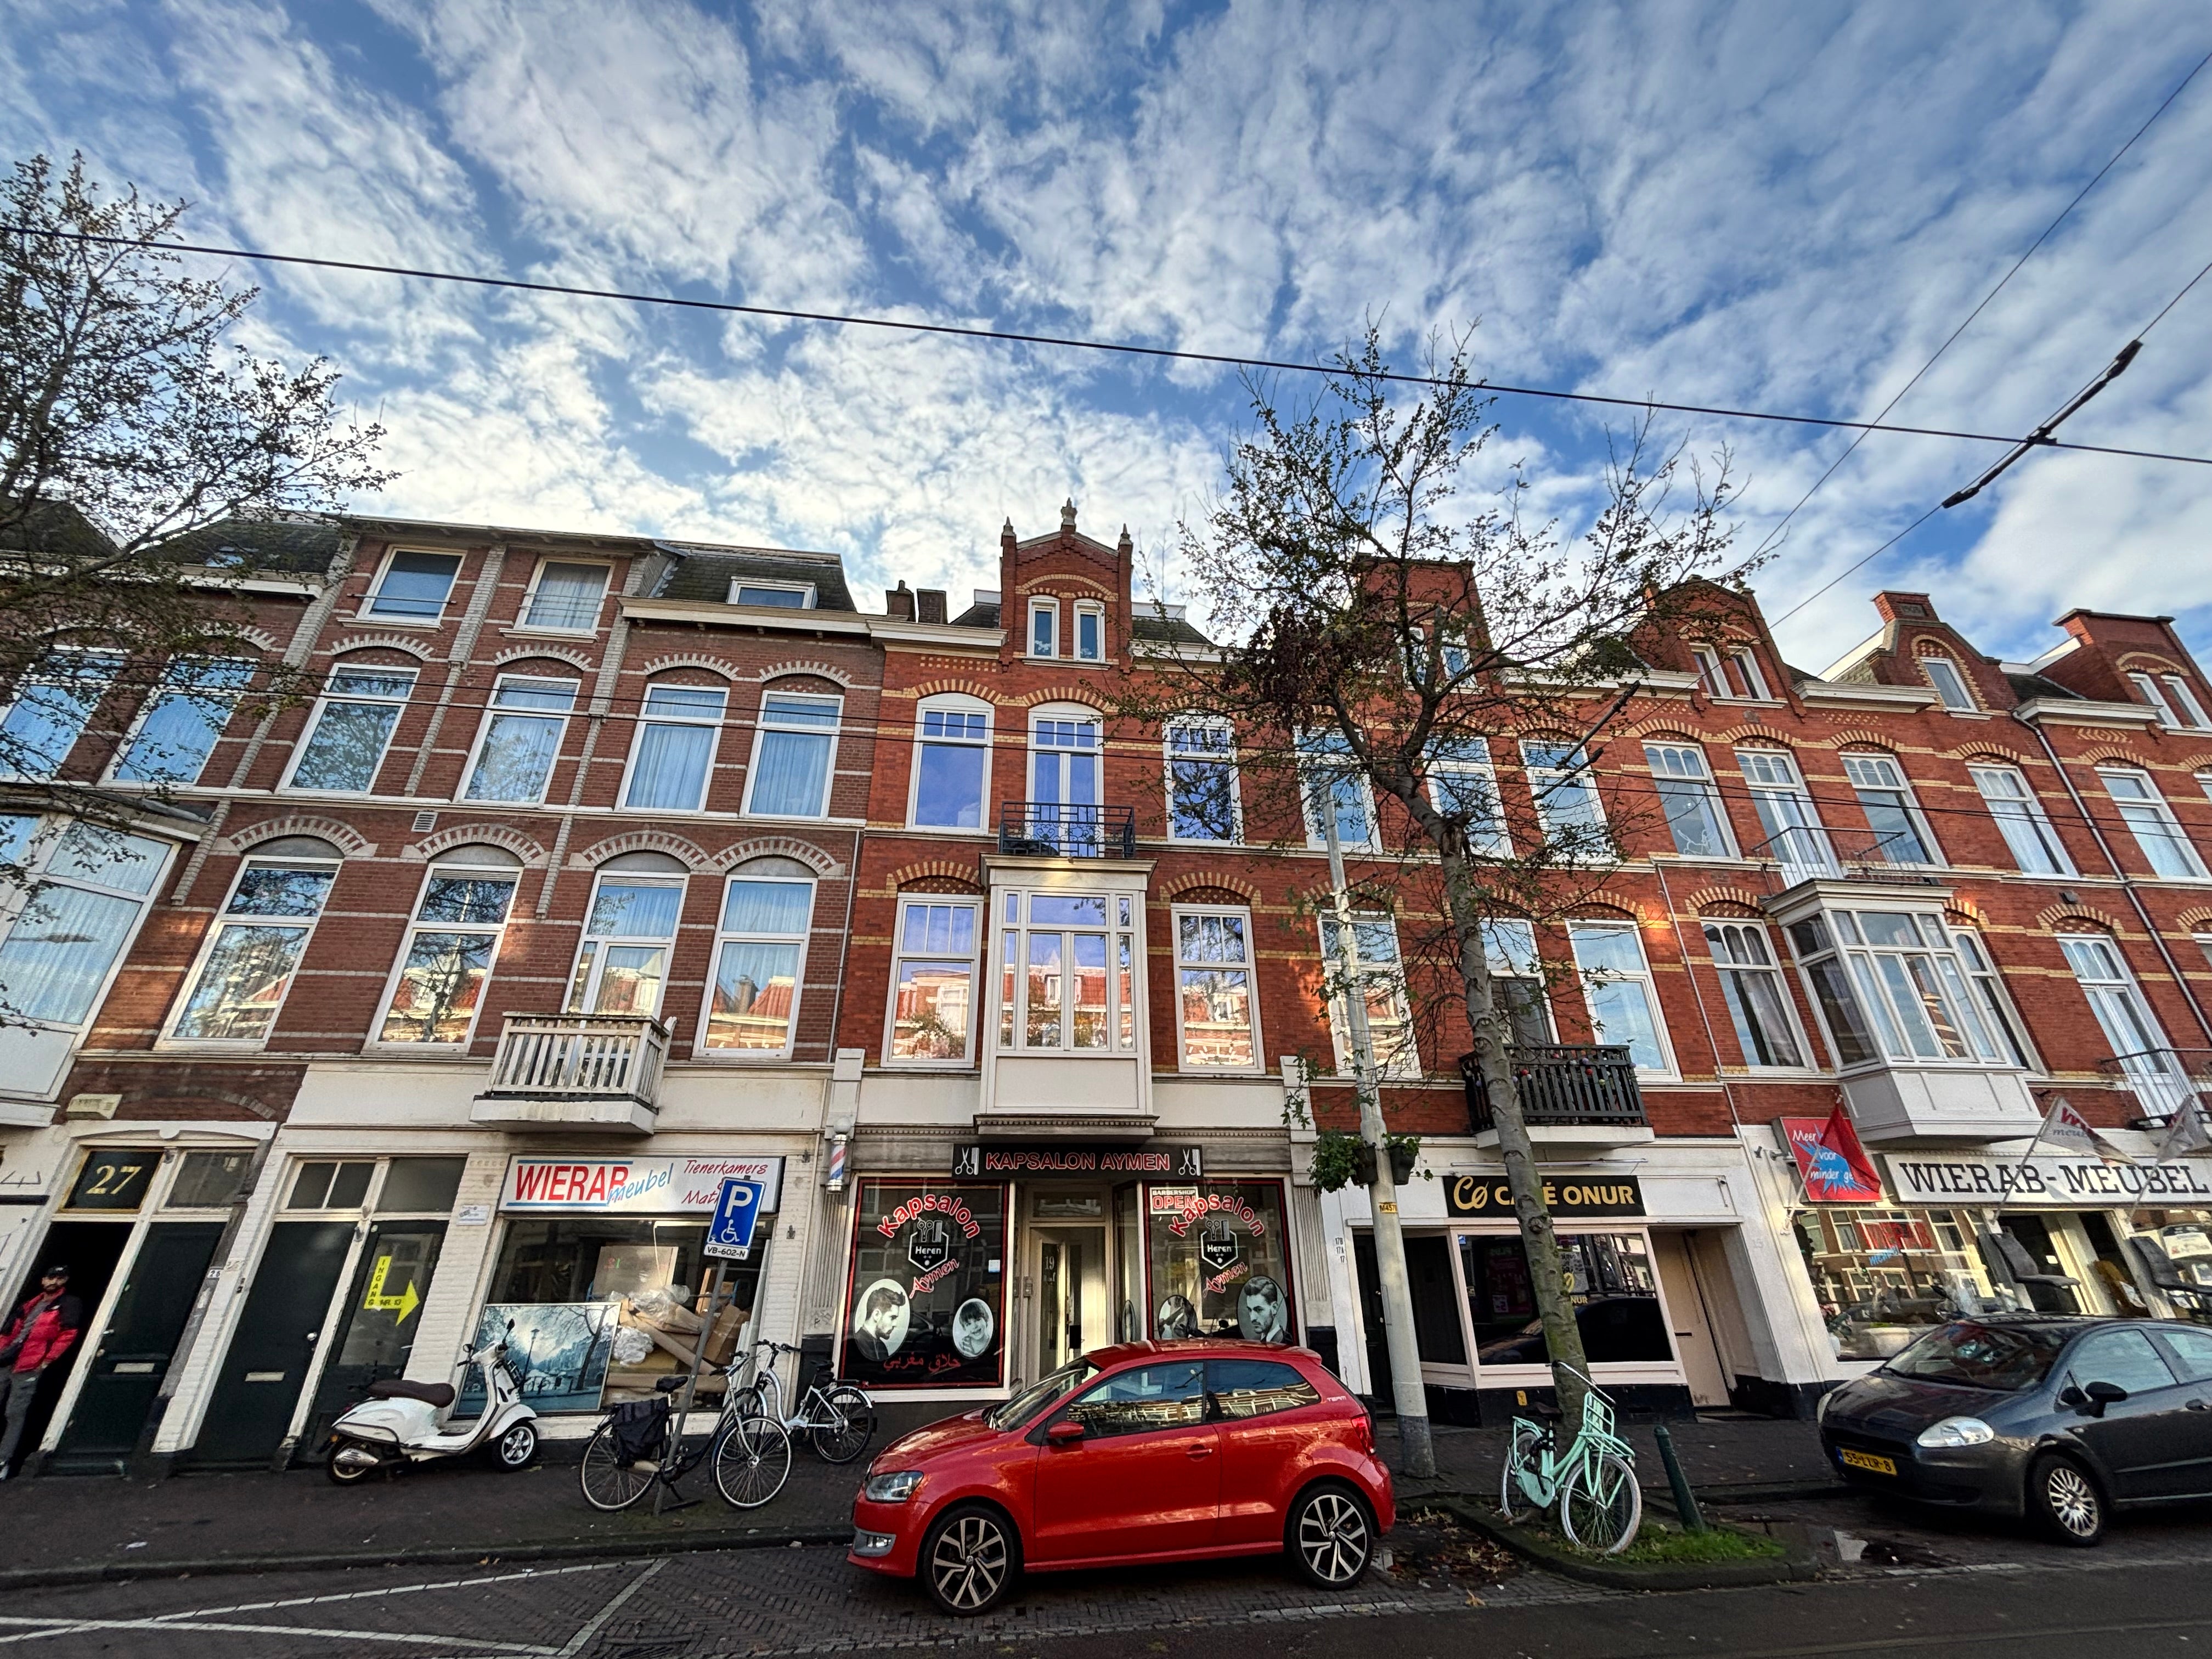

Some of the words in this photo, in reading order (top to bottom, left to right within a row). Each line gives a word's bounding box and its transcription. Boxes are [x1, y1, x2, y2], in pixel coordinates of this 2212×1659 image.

[1792, 1130, 1816, 1141] Meer
[985, 1152, 1096, 1170] KAPSALON
[1101, 1153, 1171, 1171] AYMEN
[1819, 1152, 1837, 1161] voor
[684, 1159, 769, 1175] Tienerkamers
[1810, 1167, 1839, 1180] minder
[86, 1165, 142, 1195] 27
[607, 1162, 674, 1205] meubel
[724, 1184, 753, 1218] P
[1153, 1195, 1197, 1210] OPEN
[1494, 1182, 1559, 1205] CÉ
[1563, 1186, 1636, 1205] ONUR
[877, 1194, 980, 1239] Kapsalon
[1169, 1194, 1265, 1237] Kapsalon
[707, 1246, 746, 1257] VB-602-N
[915, 1245, 942, 1255] Heren
[1207, 1244, 1232, 1252] Heren
[1044, 1255, 1055, 1270] 19
[368, 1259, 386, 1306] INGANG
[909, 1259, 960, 1300] Aymen
[1203, 1262, 1248, 1298] Aymen
[1570, 1296, 1588, 1304] NUR
[883, 1351, 924, 1372] مغربي
